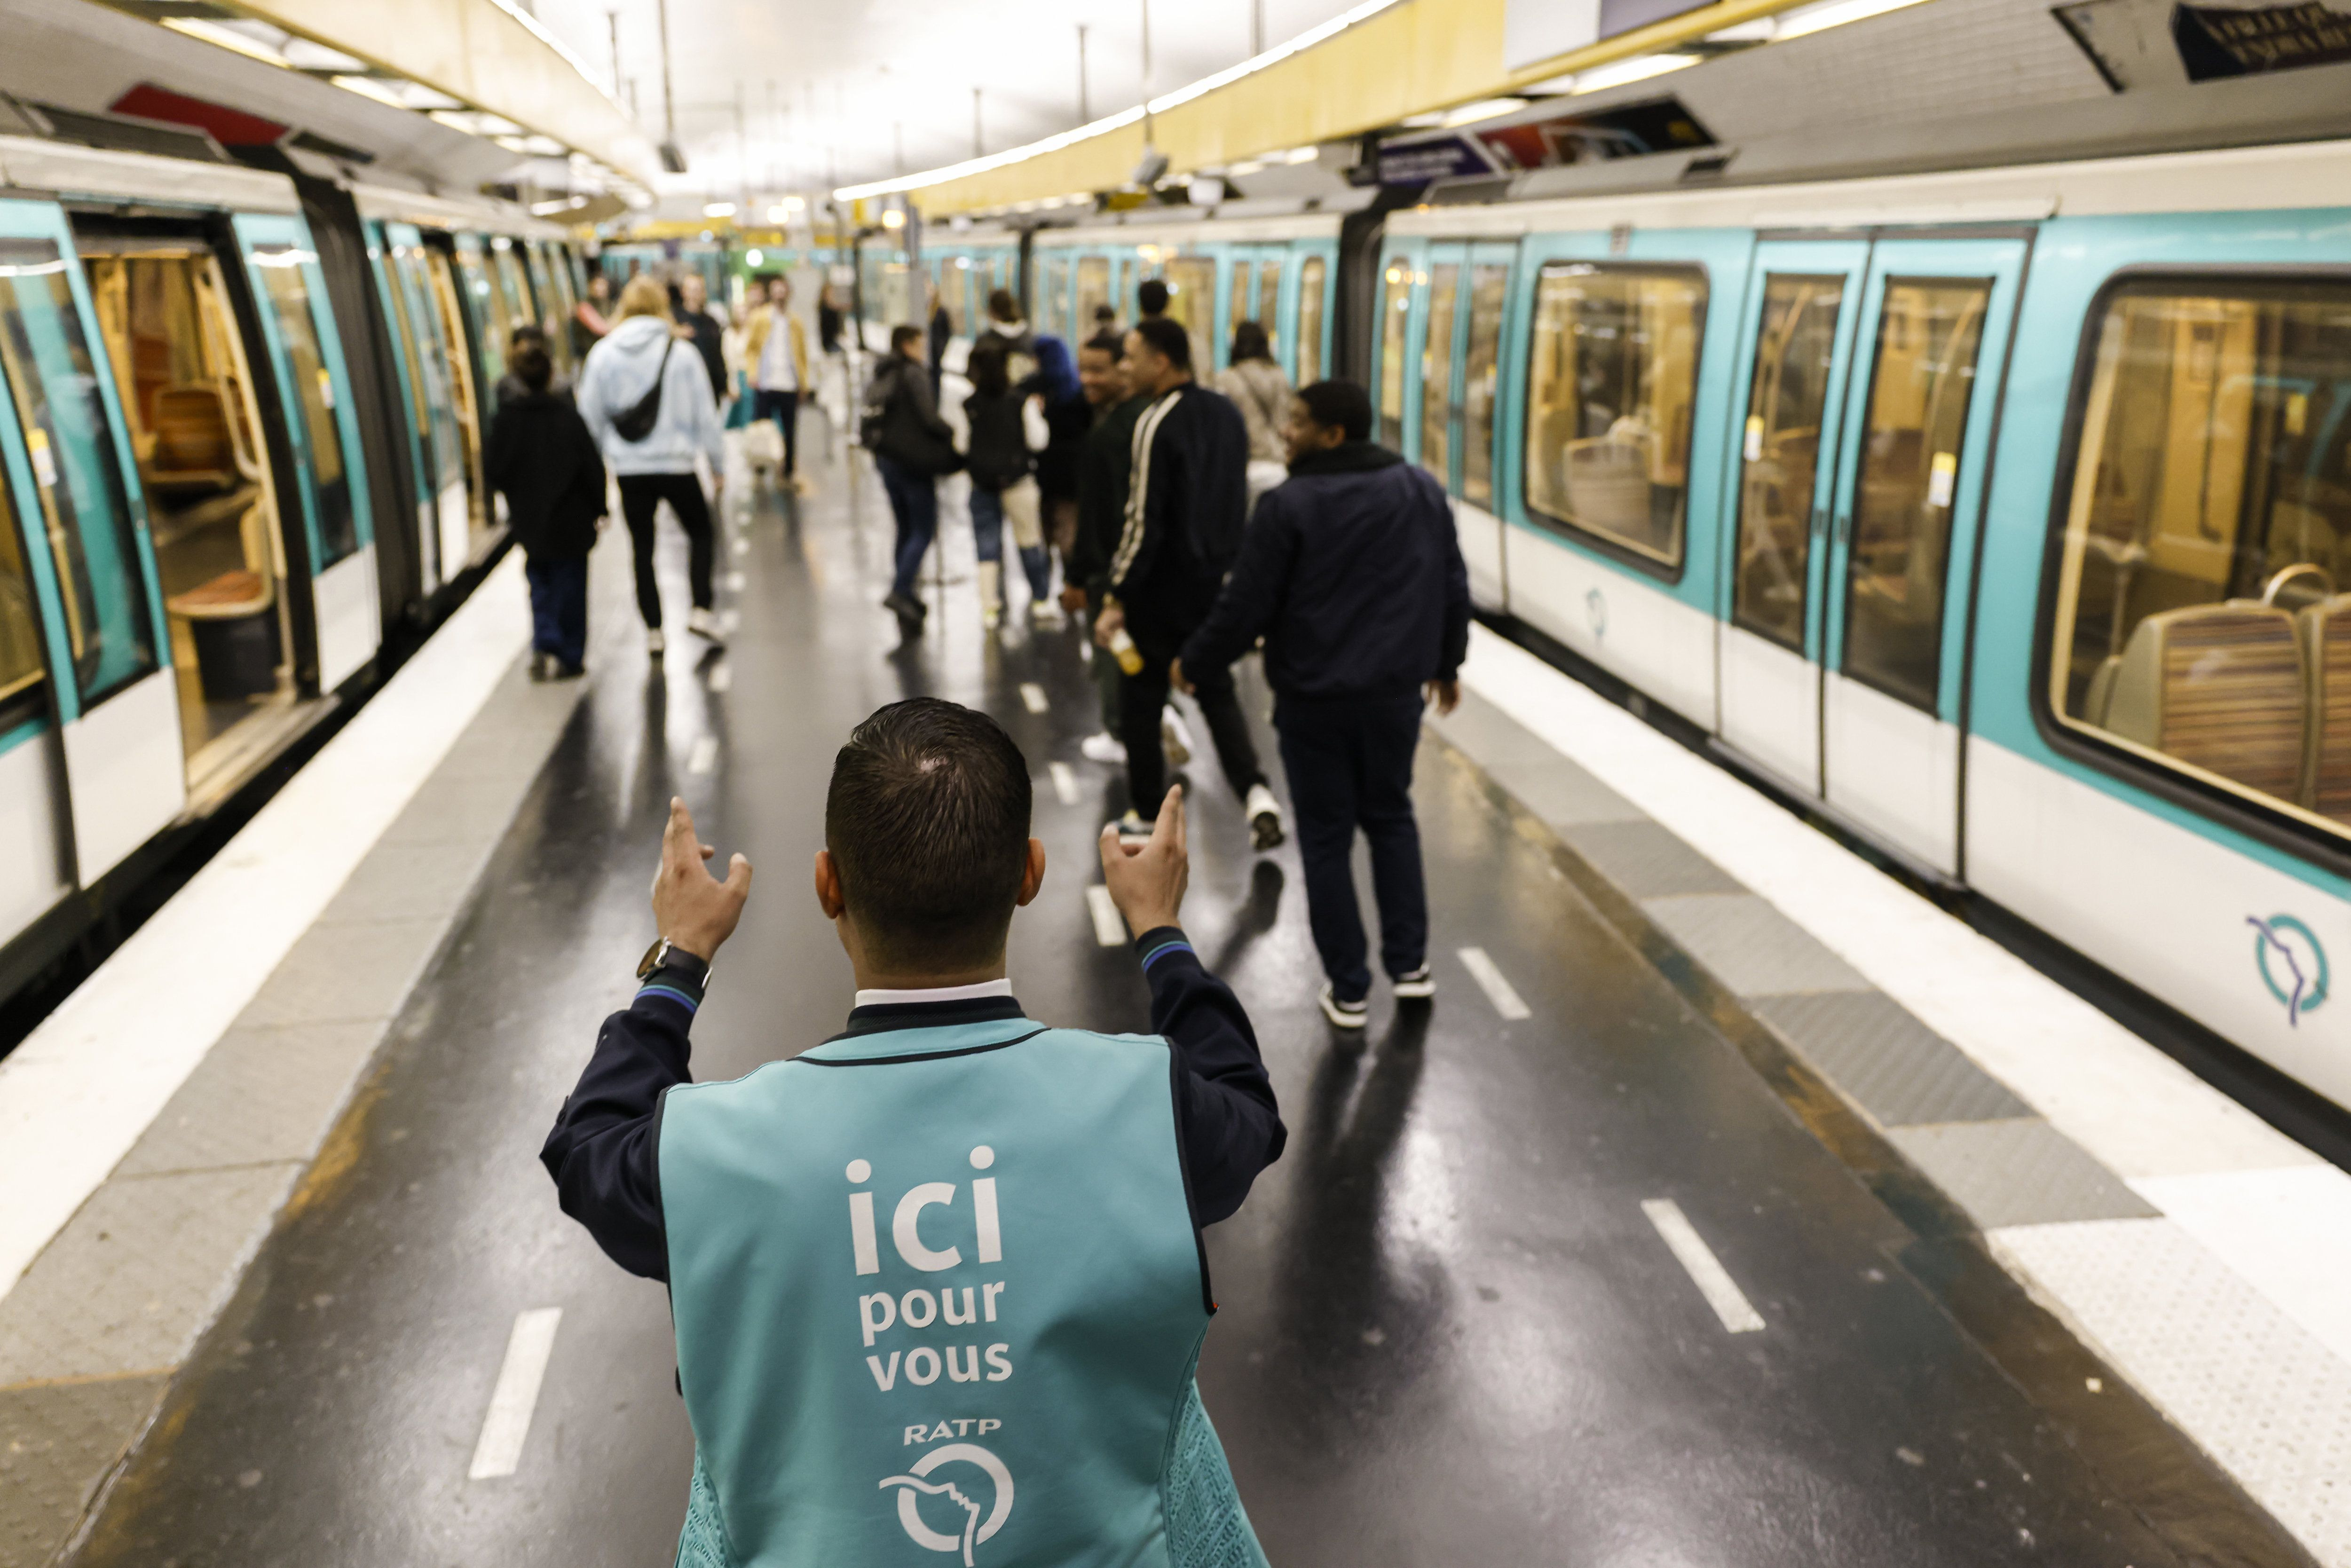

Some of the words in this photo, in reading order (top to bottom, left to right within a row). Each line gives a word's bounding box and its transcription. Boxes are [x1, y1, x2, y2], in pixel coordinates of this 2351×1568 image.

[846, 1145, 1002, 1276] ici
[859, 1280, 1006, 1347] pour
[866, 1342, 1013, 1392] vous
[903, 1418, 1002, 1446] RATP
